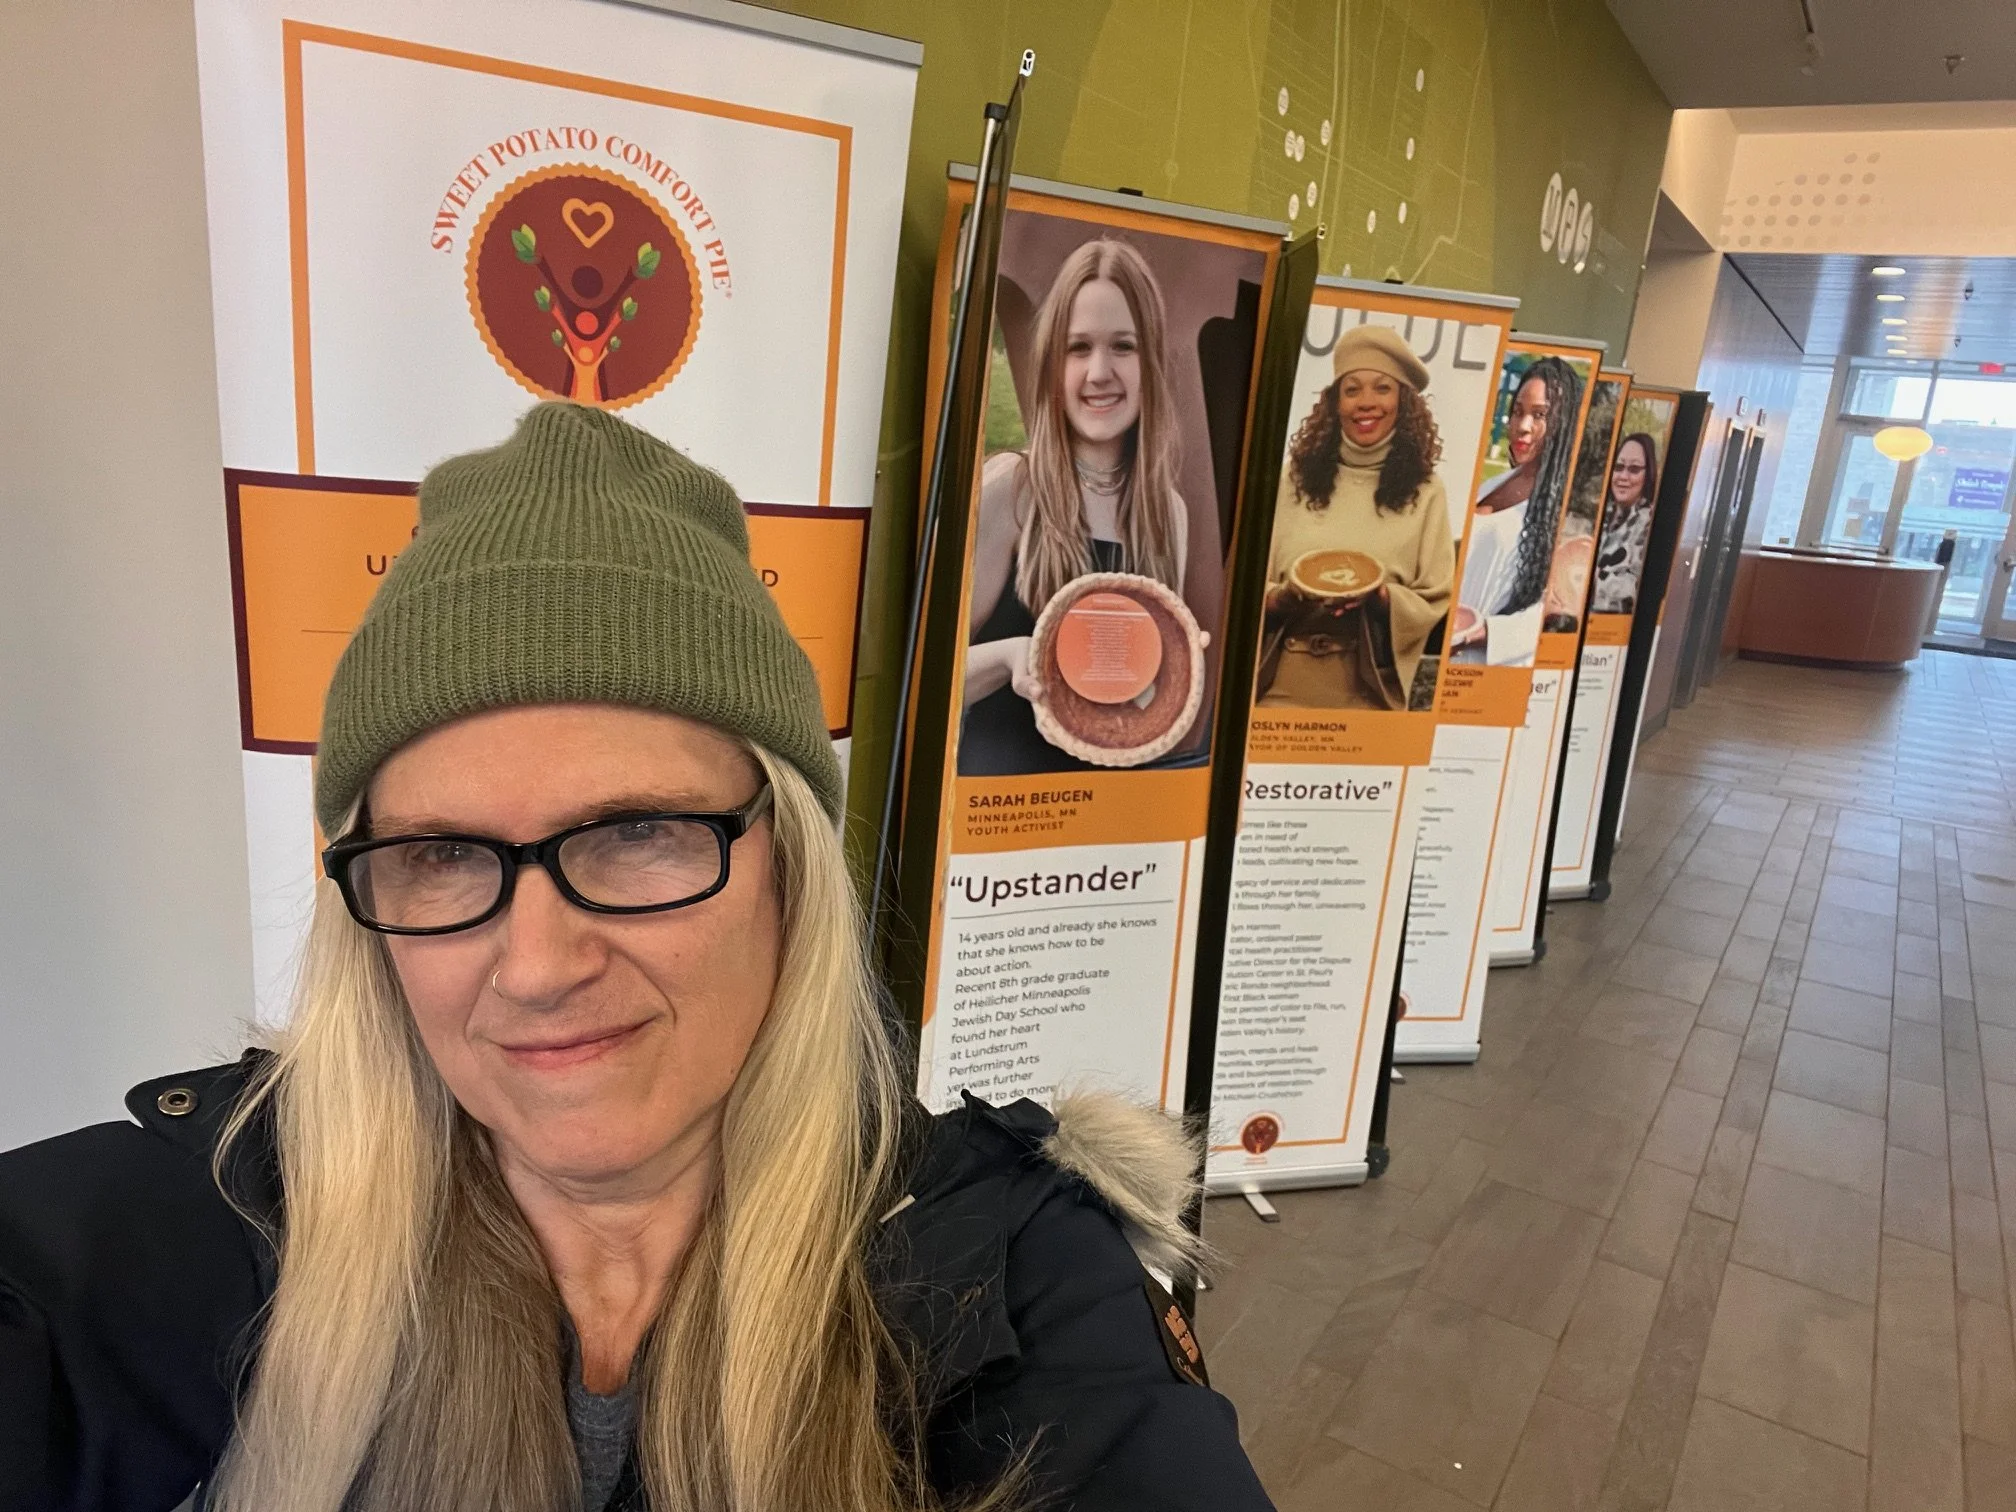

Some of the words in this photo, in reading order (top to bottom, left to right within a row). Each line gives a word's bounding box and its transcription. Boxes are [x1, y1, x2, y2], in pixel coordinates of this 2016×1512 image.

[431, 154, 491, 254] SWEET
[488, 126, 598, 167] POTATO
[605, 136, 716, 232] COMFORT
[1294, 722, 1347, 732] HARMON
[969, 794, 1025, 808] SARAH
[1030, 790, 1094, 805] BEUGEN
[968, 809, 1055, 823] MINNEAPOLIS,
[1059, 808, 1077, 817] MN
[966, 826, 1009, 836] YOUTH
[1013, 820, 1064, 833] ACTIVIST
[950, 863, 1157, 907] “Upstander”
[958, 933, 972, 943] 14
[972, 930, 1005, 945] years
[1007, 925, 1025, 938] old
[1027, 924, 1050, 936] and
[1052, 920, 1094, 934] already
[1097, 919, 1119, 930] she
[1120, 917, 1157, 928] knows
[957, 949, 983, 961] that
[985, 946, 1006, 957] she
[1008, 941, 1045, 954] knows
[1047, 939, 1073, 950] how
[1075, 938, 1088, 948] to
[1089, 936, 1105, 947] be
[956, 966, 991, 978] about
[993, 959, 1032, 973] action.
[955, 980, 997, 994] Recent
[999, 977, 1019, 989] 8th
[1021, 973, 1055, 988] grade
[1057, 968, 1110, 983] graduate
[953, 1000, 966, 1011] of
[1022, 985, 1092, 1001] Minneapolis
[952, 1013, 993, 1028] Jewish
[995, 1010, 1017, 1024] Day
[1019, 1004, 1058, 1018] School
[1060, 1001, 1086, 1013] who
[951, 1030, 986, 1044] found
[988, 1027, 1008, 1039] her
[1010, 1022, 1041, 1036] heart
[950, 1050, 962, 1061] at
[964, 1040, 1029, 1059] Lundstrum
[949, 1058, 1014, 1076] Performing
[1016, 1054, 1041, 1066] Arts
[967, 1078, 991, 1090] was
[993, 1071, 1034, 1086] further
[995, 1090, 1007, 1101] to
[1009, 1088, 1025, 1099] do
